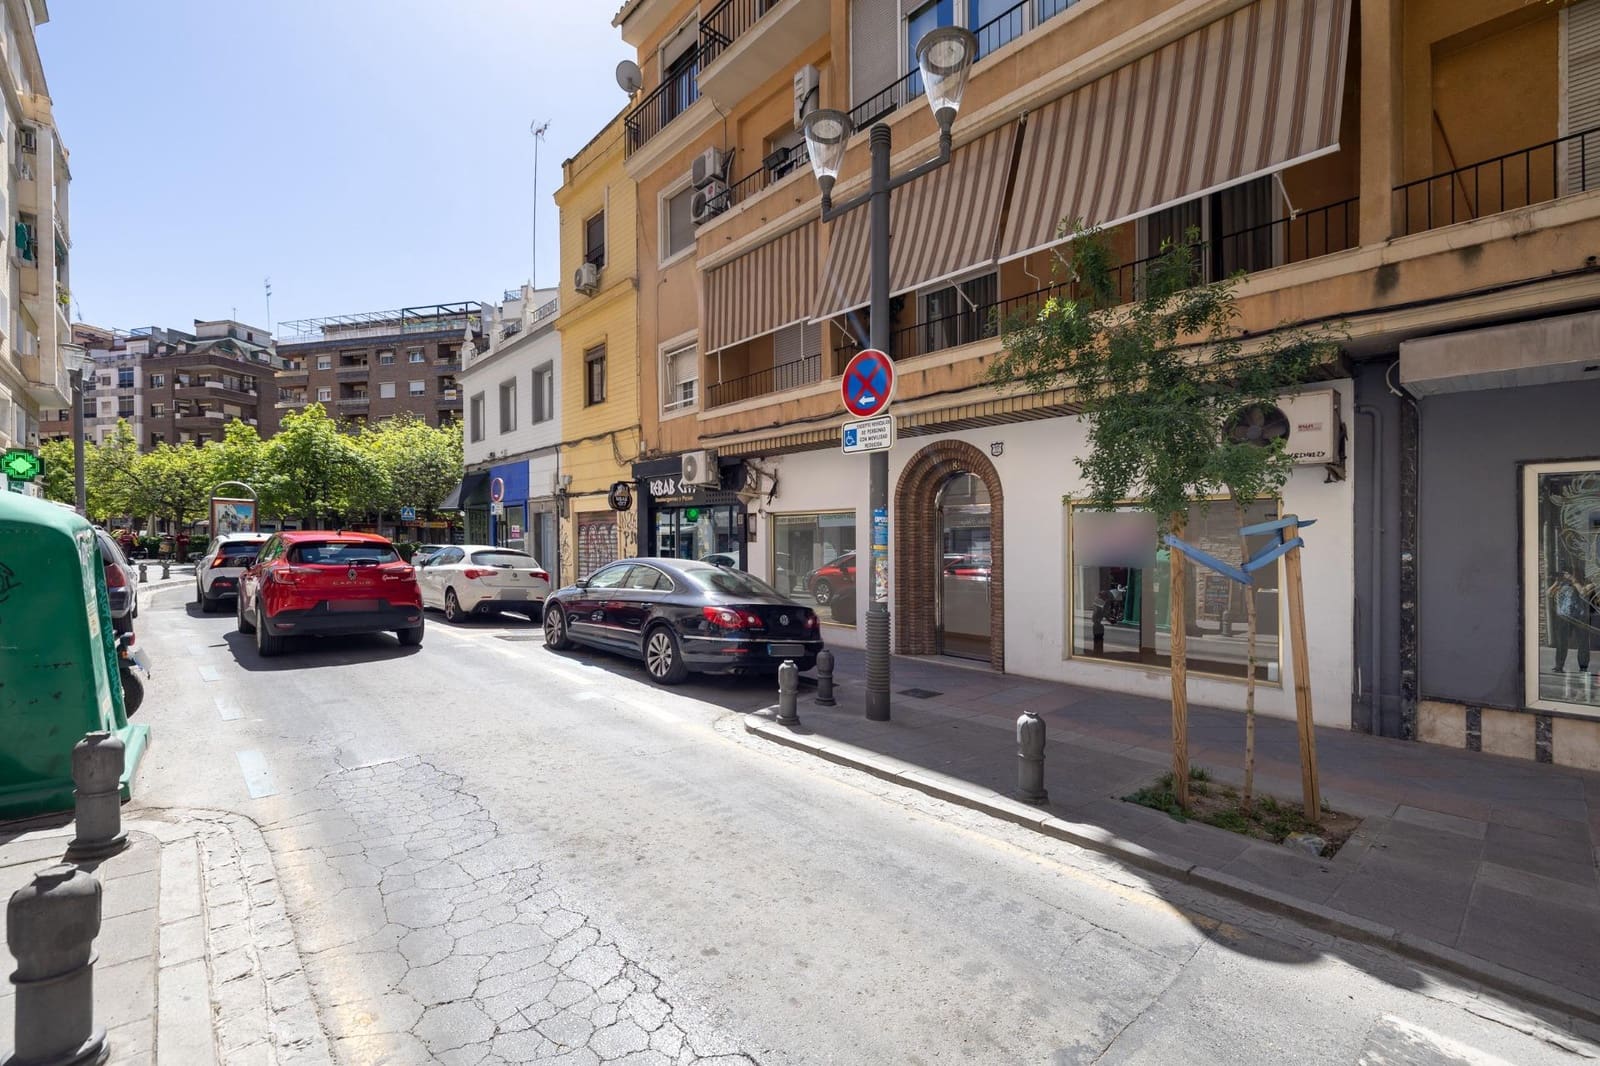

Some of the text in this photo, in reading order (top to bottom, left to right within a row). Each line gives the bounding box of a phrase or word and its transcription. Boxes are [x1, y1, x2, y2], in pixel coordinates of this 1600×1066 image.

[867, 426, 886, 434] PERSONAS
[868, 433, 888, 441] MOVILIDAD
[650, 478, 675, 496] KEBAB
